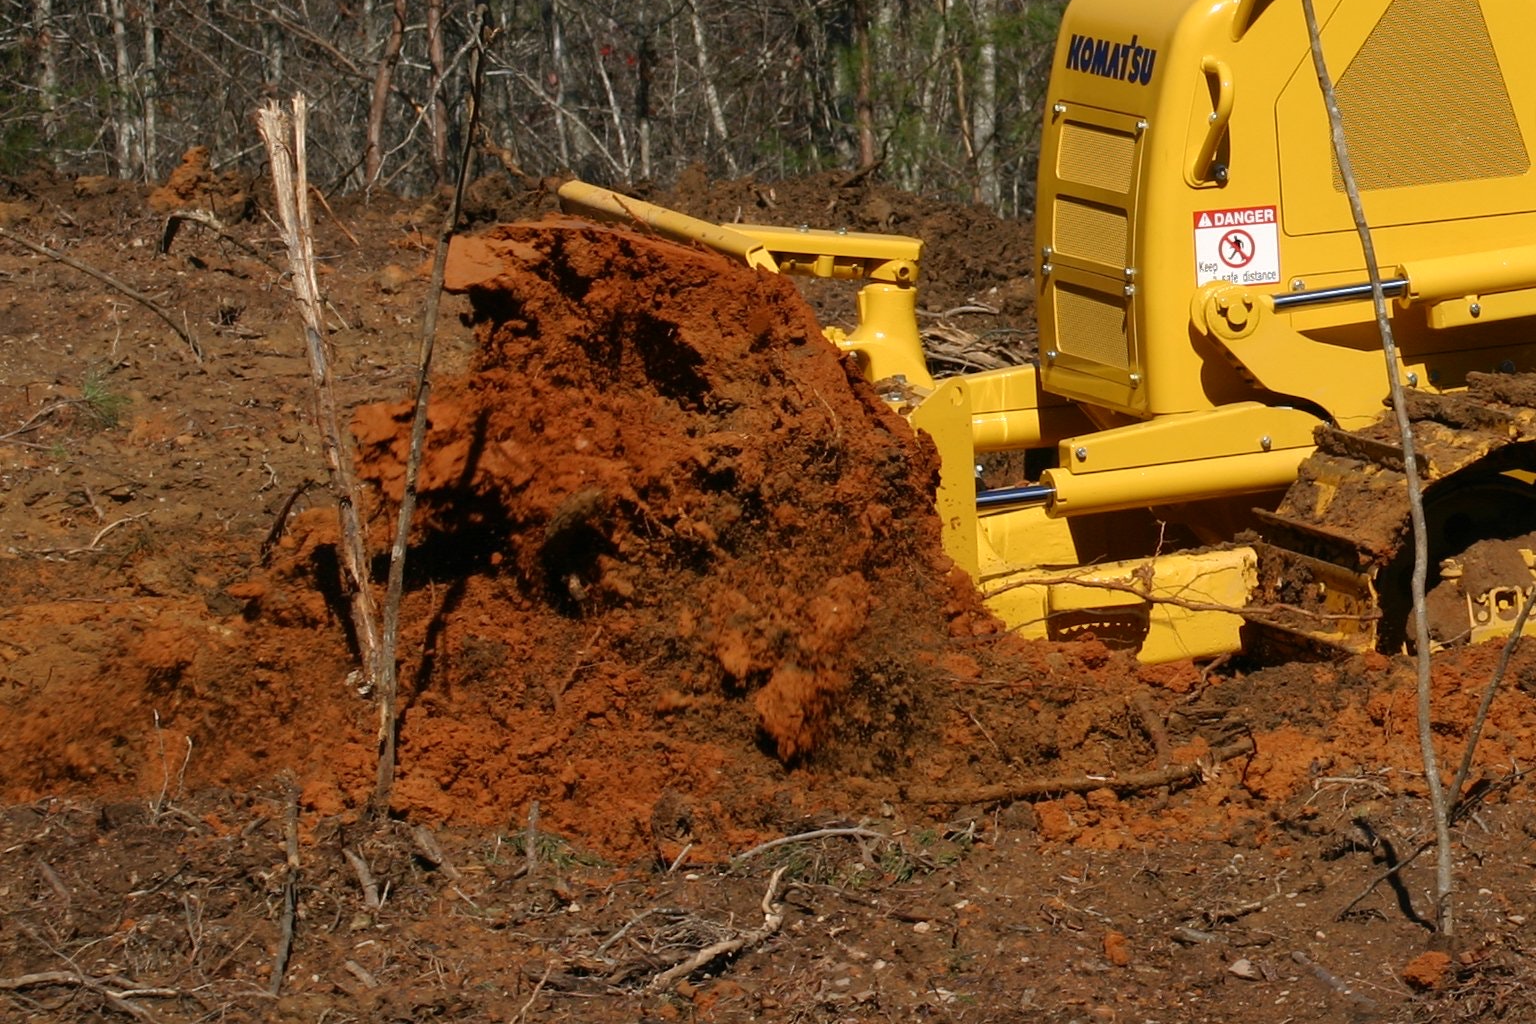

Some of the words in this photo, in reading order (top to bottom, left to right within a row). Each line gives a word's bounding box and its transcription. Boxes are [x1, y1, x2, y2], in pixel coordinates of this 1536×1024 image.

[1065, 33, 1157, 86] KOMATSU
[1214, 208, 1275, 226] DANGER
[1198, 261, 1218, 274] Keep
[1242, 270, 1277, 283] distance
